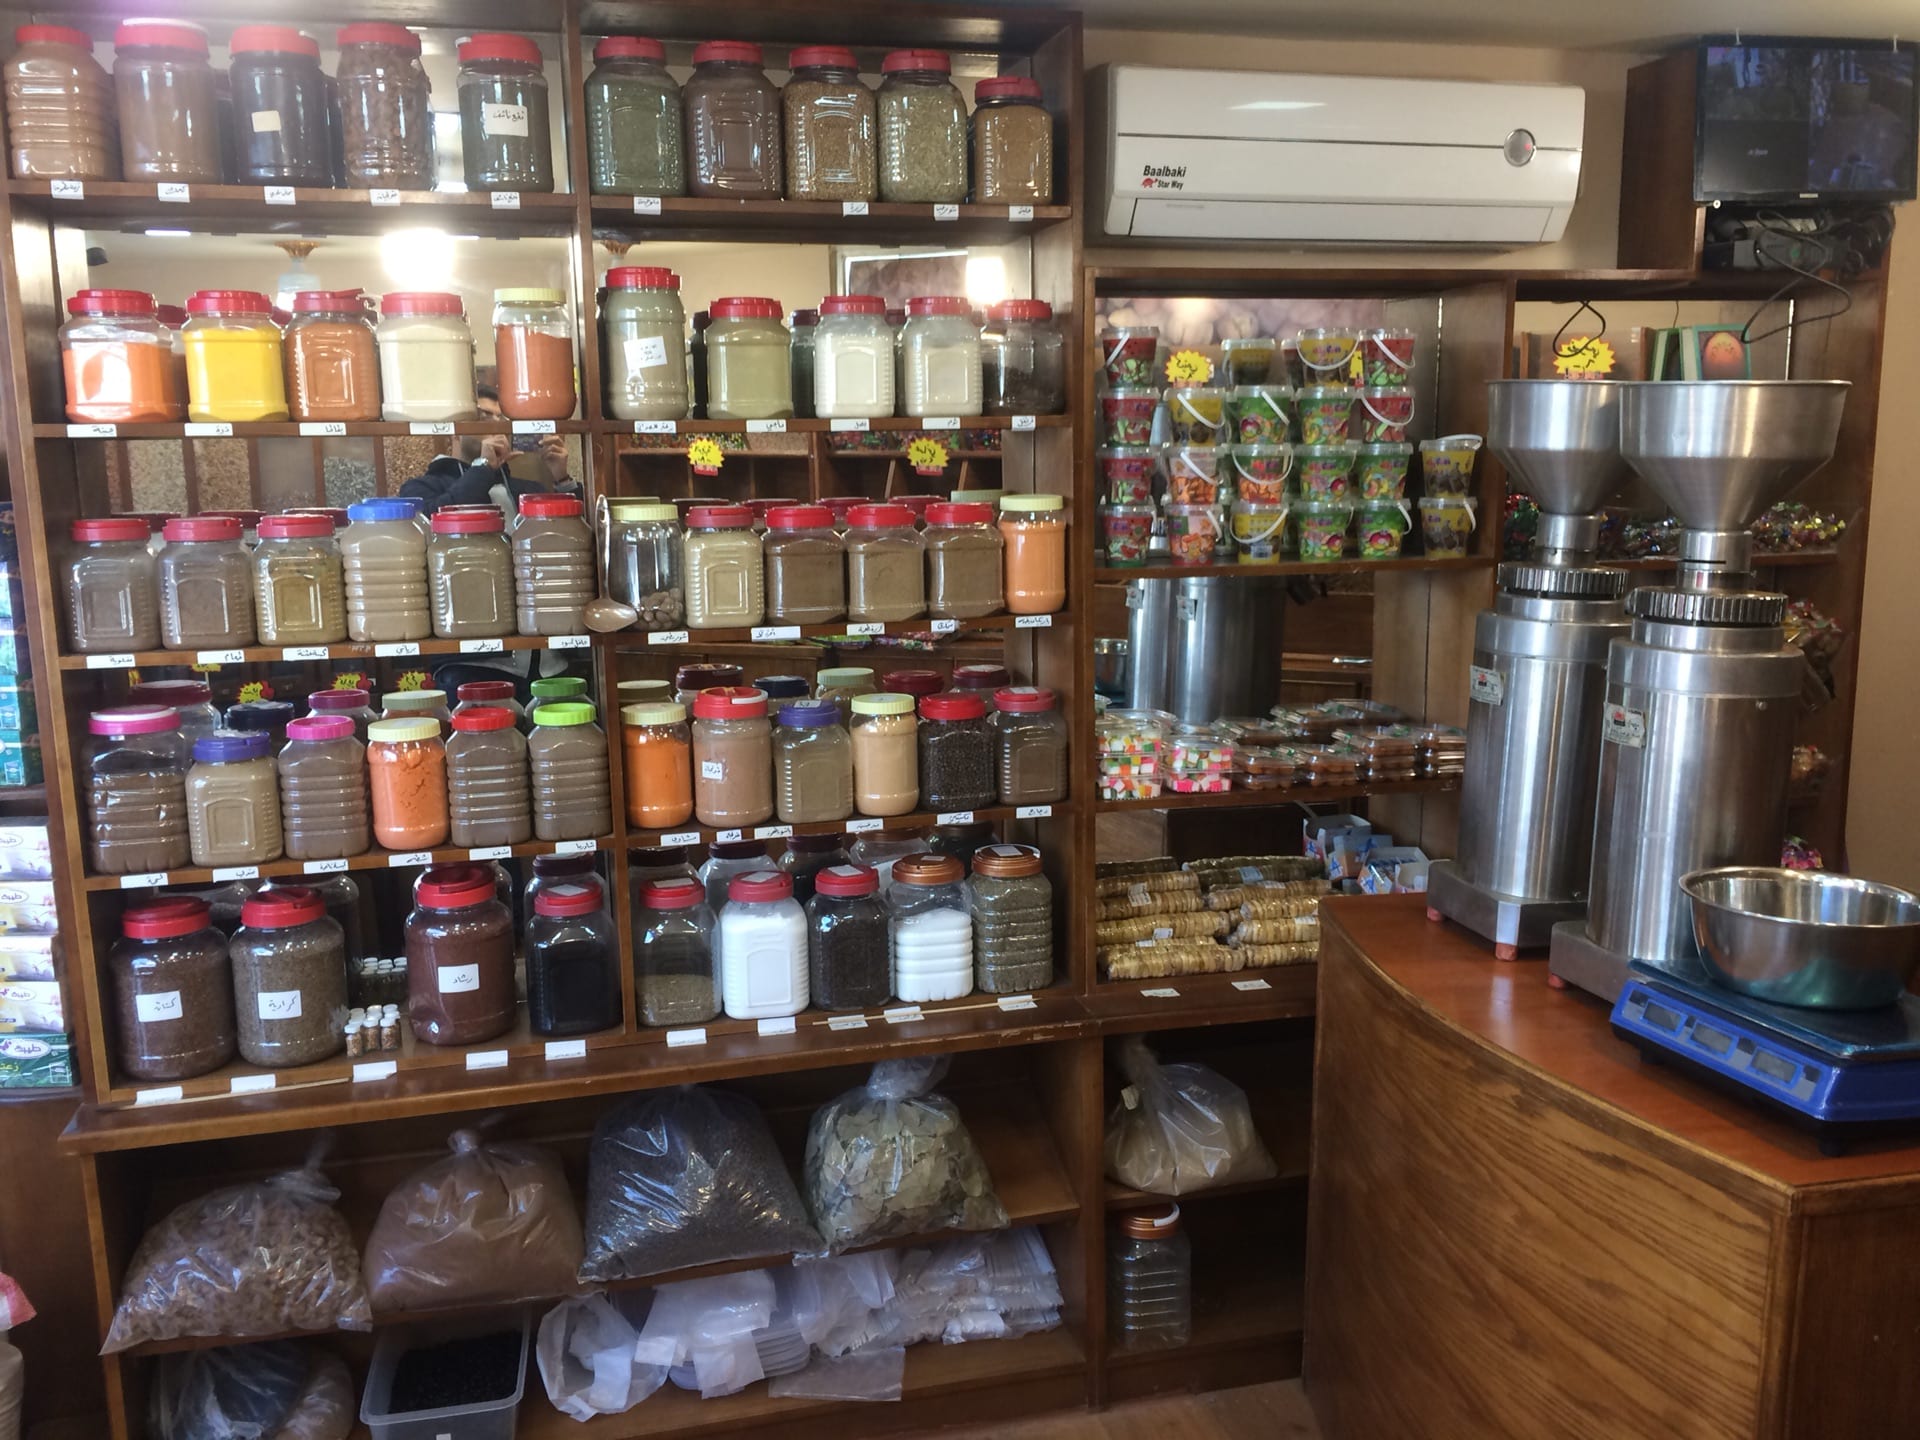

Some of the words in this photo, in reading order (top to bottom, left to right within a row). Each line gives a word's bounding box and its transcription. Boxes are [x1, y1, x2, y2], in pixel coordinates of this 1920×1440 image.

[1143, 165, 1187, 177] Baalbaki
[1157, 180, 1170, 188] Star
[1171, 181, 1184, 190] Way
